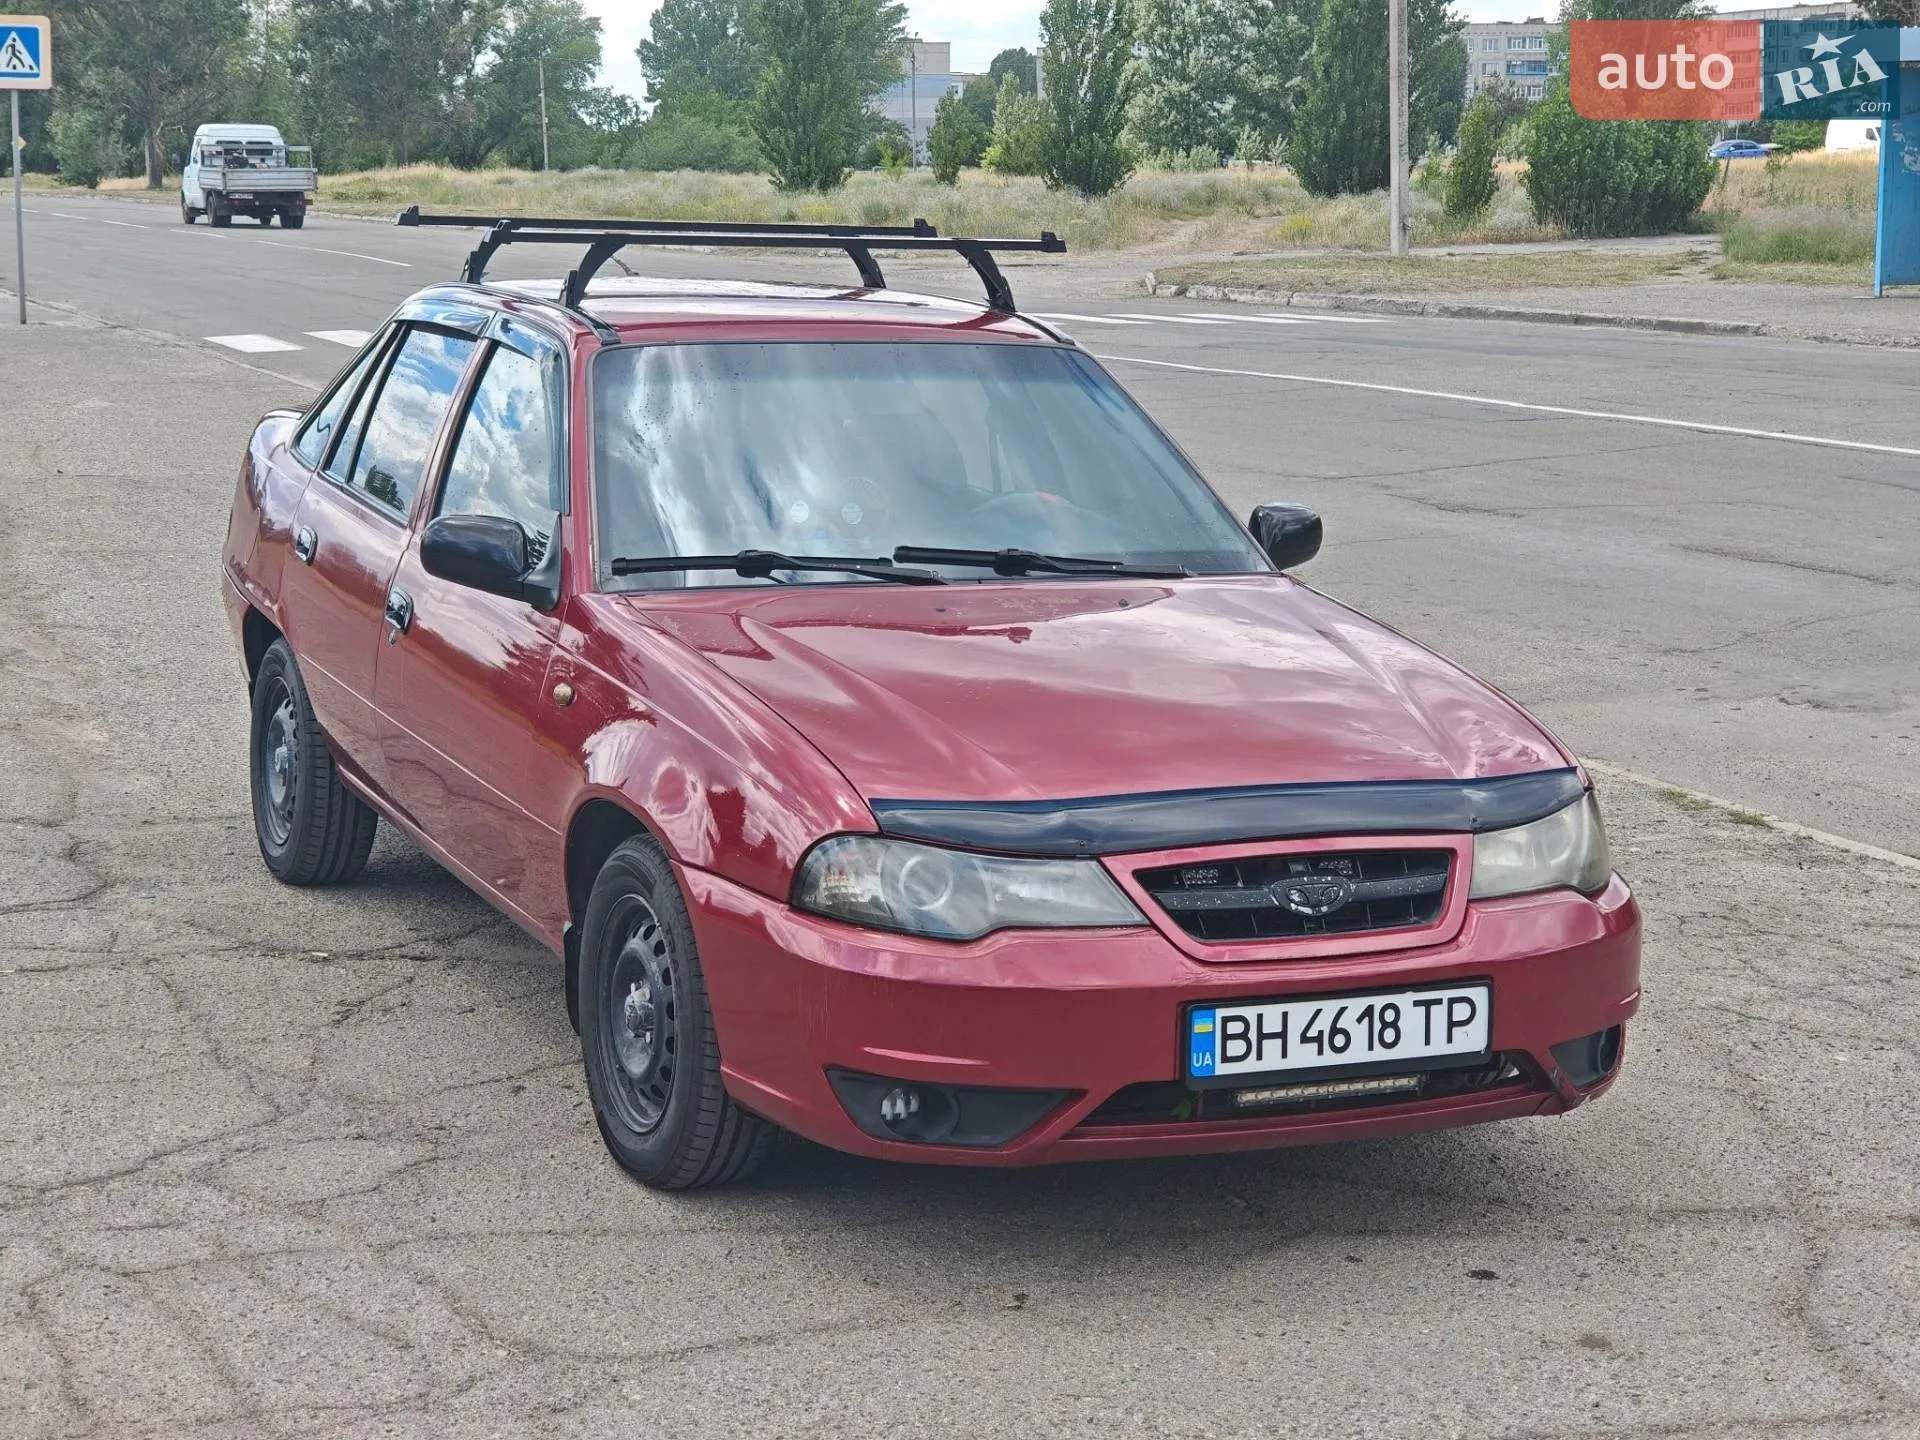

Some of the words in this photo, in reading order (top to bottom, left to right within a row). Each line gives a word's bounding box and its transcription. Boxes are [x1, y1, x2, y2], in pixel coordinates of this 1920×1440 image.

[1220, 1011, 1289, 1065] BH
[1299, 1002, 1401, 1057] 4618
[1412, 995, 1477, 1047] TP
[1193, 1052, 1213, 1068] UA
